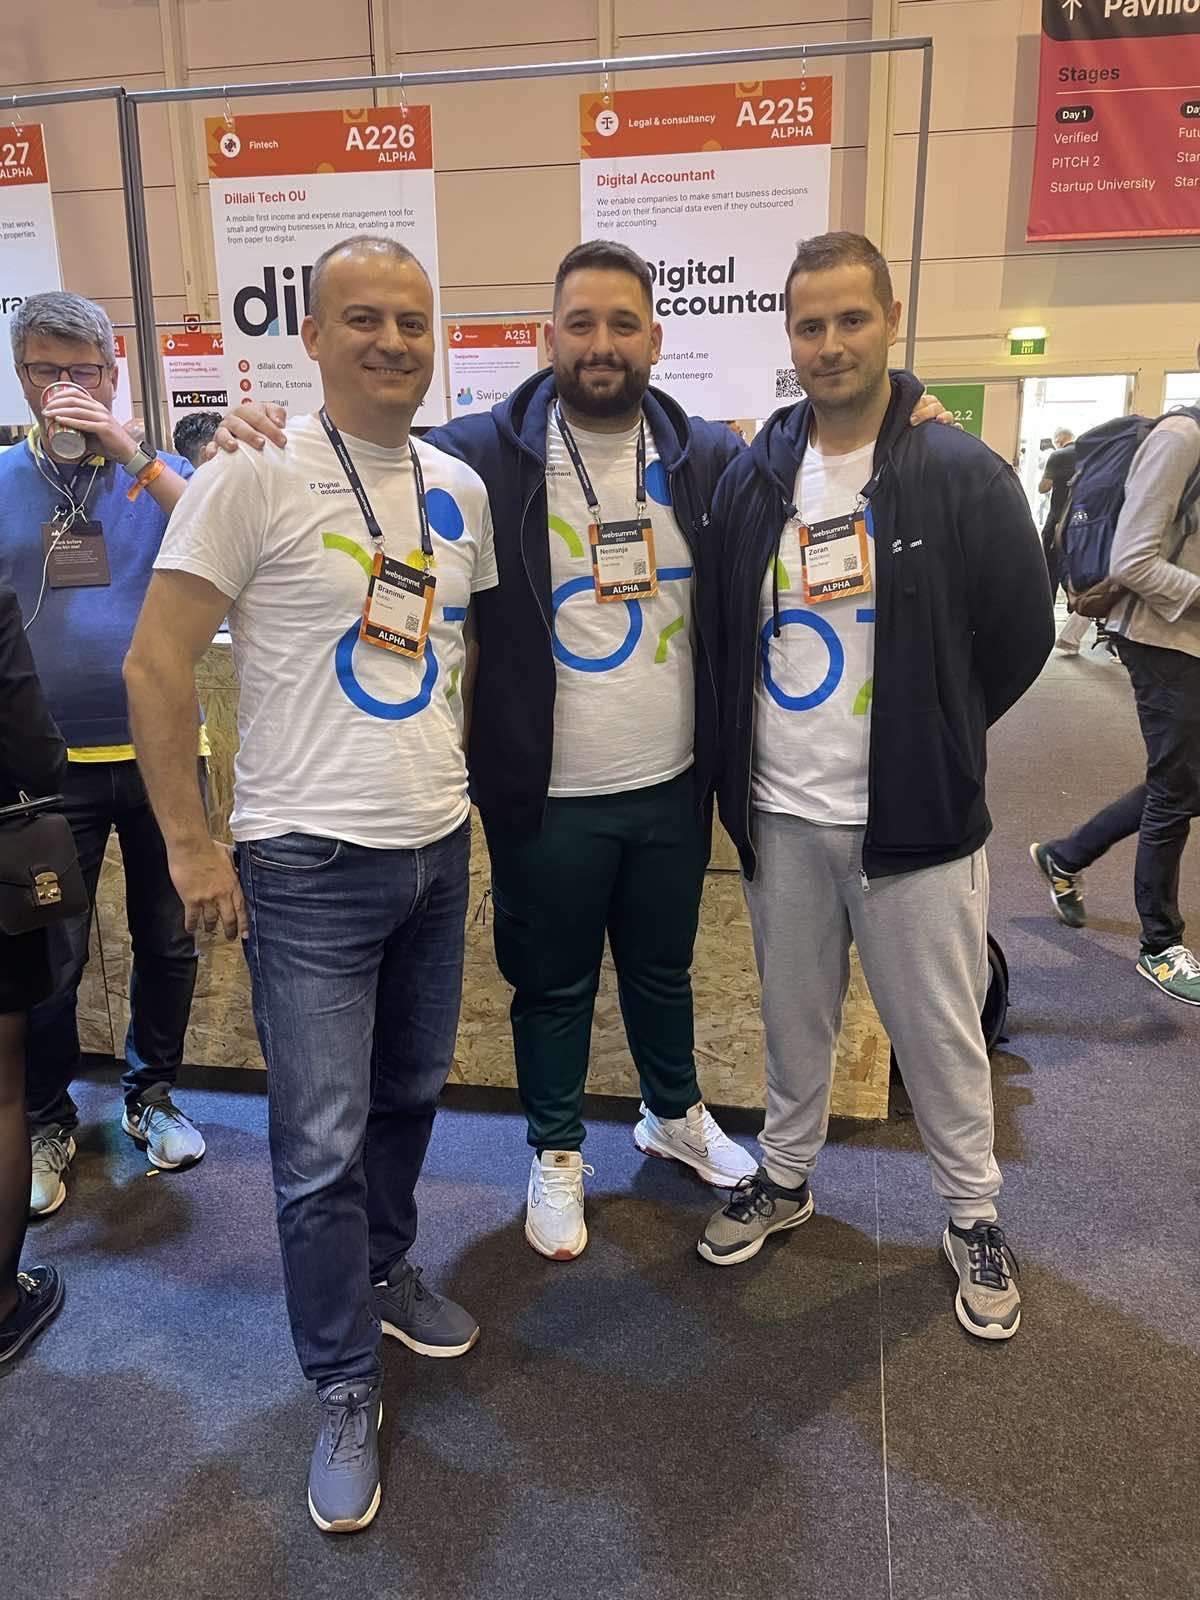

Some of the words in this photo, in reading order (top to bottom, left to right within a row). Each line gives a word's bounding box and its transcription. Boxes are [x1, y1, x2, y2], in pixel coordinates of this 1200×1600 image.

[1058, 66, 1120, 83] Stages
[736, 96, 814, 127] A225
[1062, 111, 1080, 121] Day
[1082, 110, 1087, 119] 1
[628, 118, 652, 128] Legal
[654, 118, 660, 126] &
[661, 114, 716, 126] consultancy
[345, 124, 416, 151] A226
[770, 125, 814, 139] ALPHA
[1054, 131, 1099, 145] Verified
[249, 140, 279, 149] Fintech
[0, 142, 29, 167] 27
[378, 151, 416, 163] ALPHA
[1052, 157, 1089, 168] PITCH
[1093, 155, 1100, 167] 2
[0, 167, 33, 178] ALPHA
[597, 173, 638, 188] Digital
[640, 169, 716, 184] Accountant
[1050, 181, 1094, 193] Startup
[1097, 178, 1156, 191] University
[224, 192, 256, 205] Dillali
[259, 190, 286, 203] Tech
[288, 190, 307, 201] OU
[597, 197, 609, 206] We
[610, 196, 636, 205] enable
[637, 193, 679, 204] companies
[680, 192, 688, 201] to
[689, 192, 710, 201] make
[712, 190, 734, 200] smart
[736, 188, 770, 199] business
[771, 186, 808, 197] decisions
[232, 213, 255, 222] mobile
[256, 212, 270, 221] first
[271, 211, 296, 221] income
[297, 210, 310, 220] and
[311, 210, 341, 221] expense
[341, 209, 387, 219] management
[388, 208, 403, 217] tool
[404, 207, 414, 217] for
[597, 208, 620, 218] based
[621, 207, 632, 216] on
[633, 206, 650, 216] their
[652, 205, 684, 214] financial
[685, 204, 702, 213] data
[703, 204, 723, 212] even
[724, 202, 729, 211] if
[731, 202, 748, 212] they
[749, 199, 794, 209] outsourced
[16, 219, 34, 228] works
[227, 225, 244, 234] small
[245, 224, 258, 233] and
[259, 223, 287, 234] growing
[287, 221, 326, 232] businesses
[327, 220, 334, 230] in
[335, 219, 357, 230] Africa,
[358, 218, 389, 229] enabling
[395, 217, 416, 227] move
[597, 219, 614, 229] their
[3, 230, 36, 241] properties
[227, 236, 243, 245] from
[244, 235, 264, 245] paper
[265, 234, 273, 243] to
[505, 329, 531, 341] A251
[257, 362, 293, 370] dillali.com
[664, 371, 714, 381] Montenegro
[258, 380, 284, 390] Tallinn,
[285, 379, 312, 388] Estonia
[175, 392, 226, 404] Art2Tradi
[476, 389, 512, 401] Swipe
[318, 482, 341, 490] Digital
[601, 530, 638, 539] websummit
[812, 524, 849, 538] websummit
[808, 546, 829, 556] Zoran
[377, 584, 406, 600] Branimir
[612, 584, 640, 594] ALPHA
[823, 580, 851, 593] ALPHA
[378, 630, 406, 648] ALPHA
